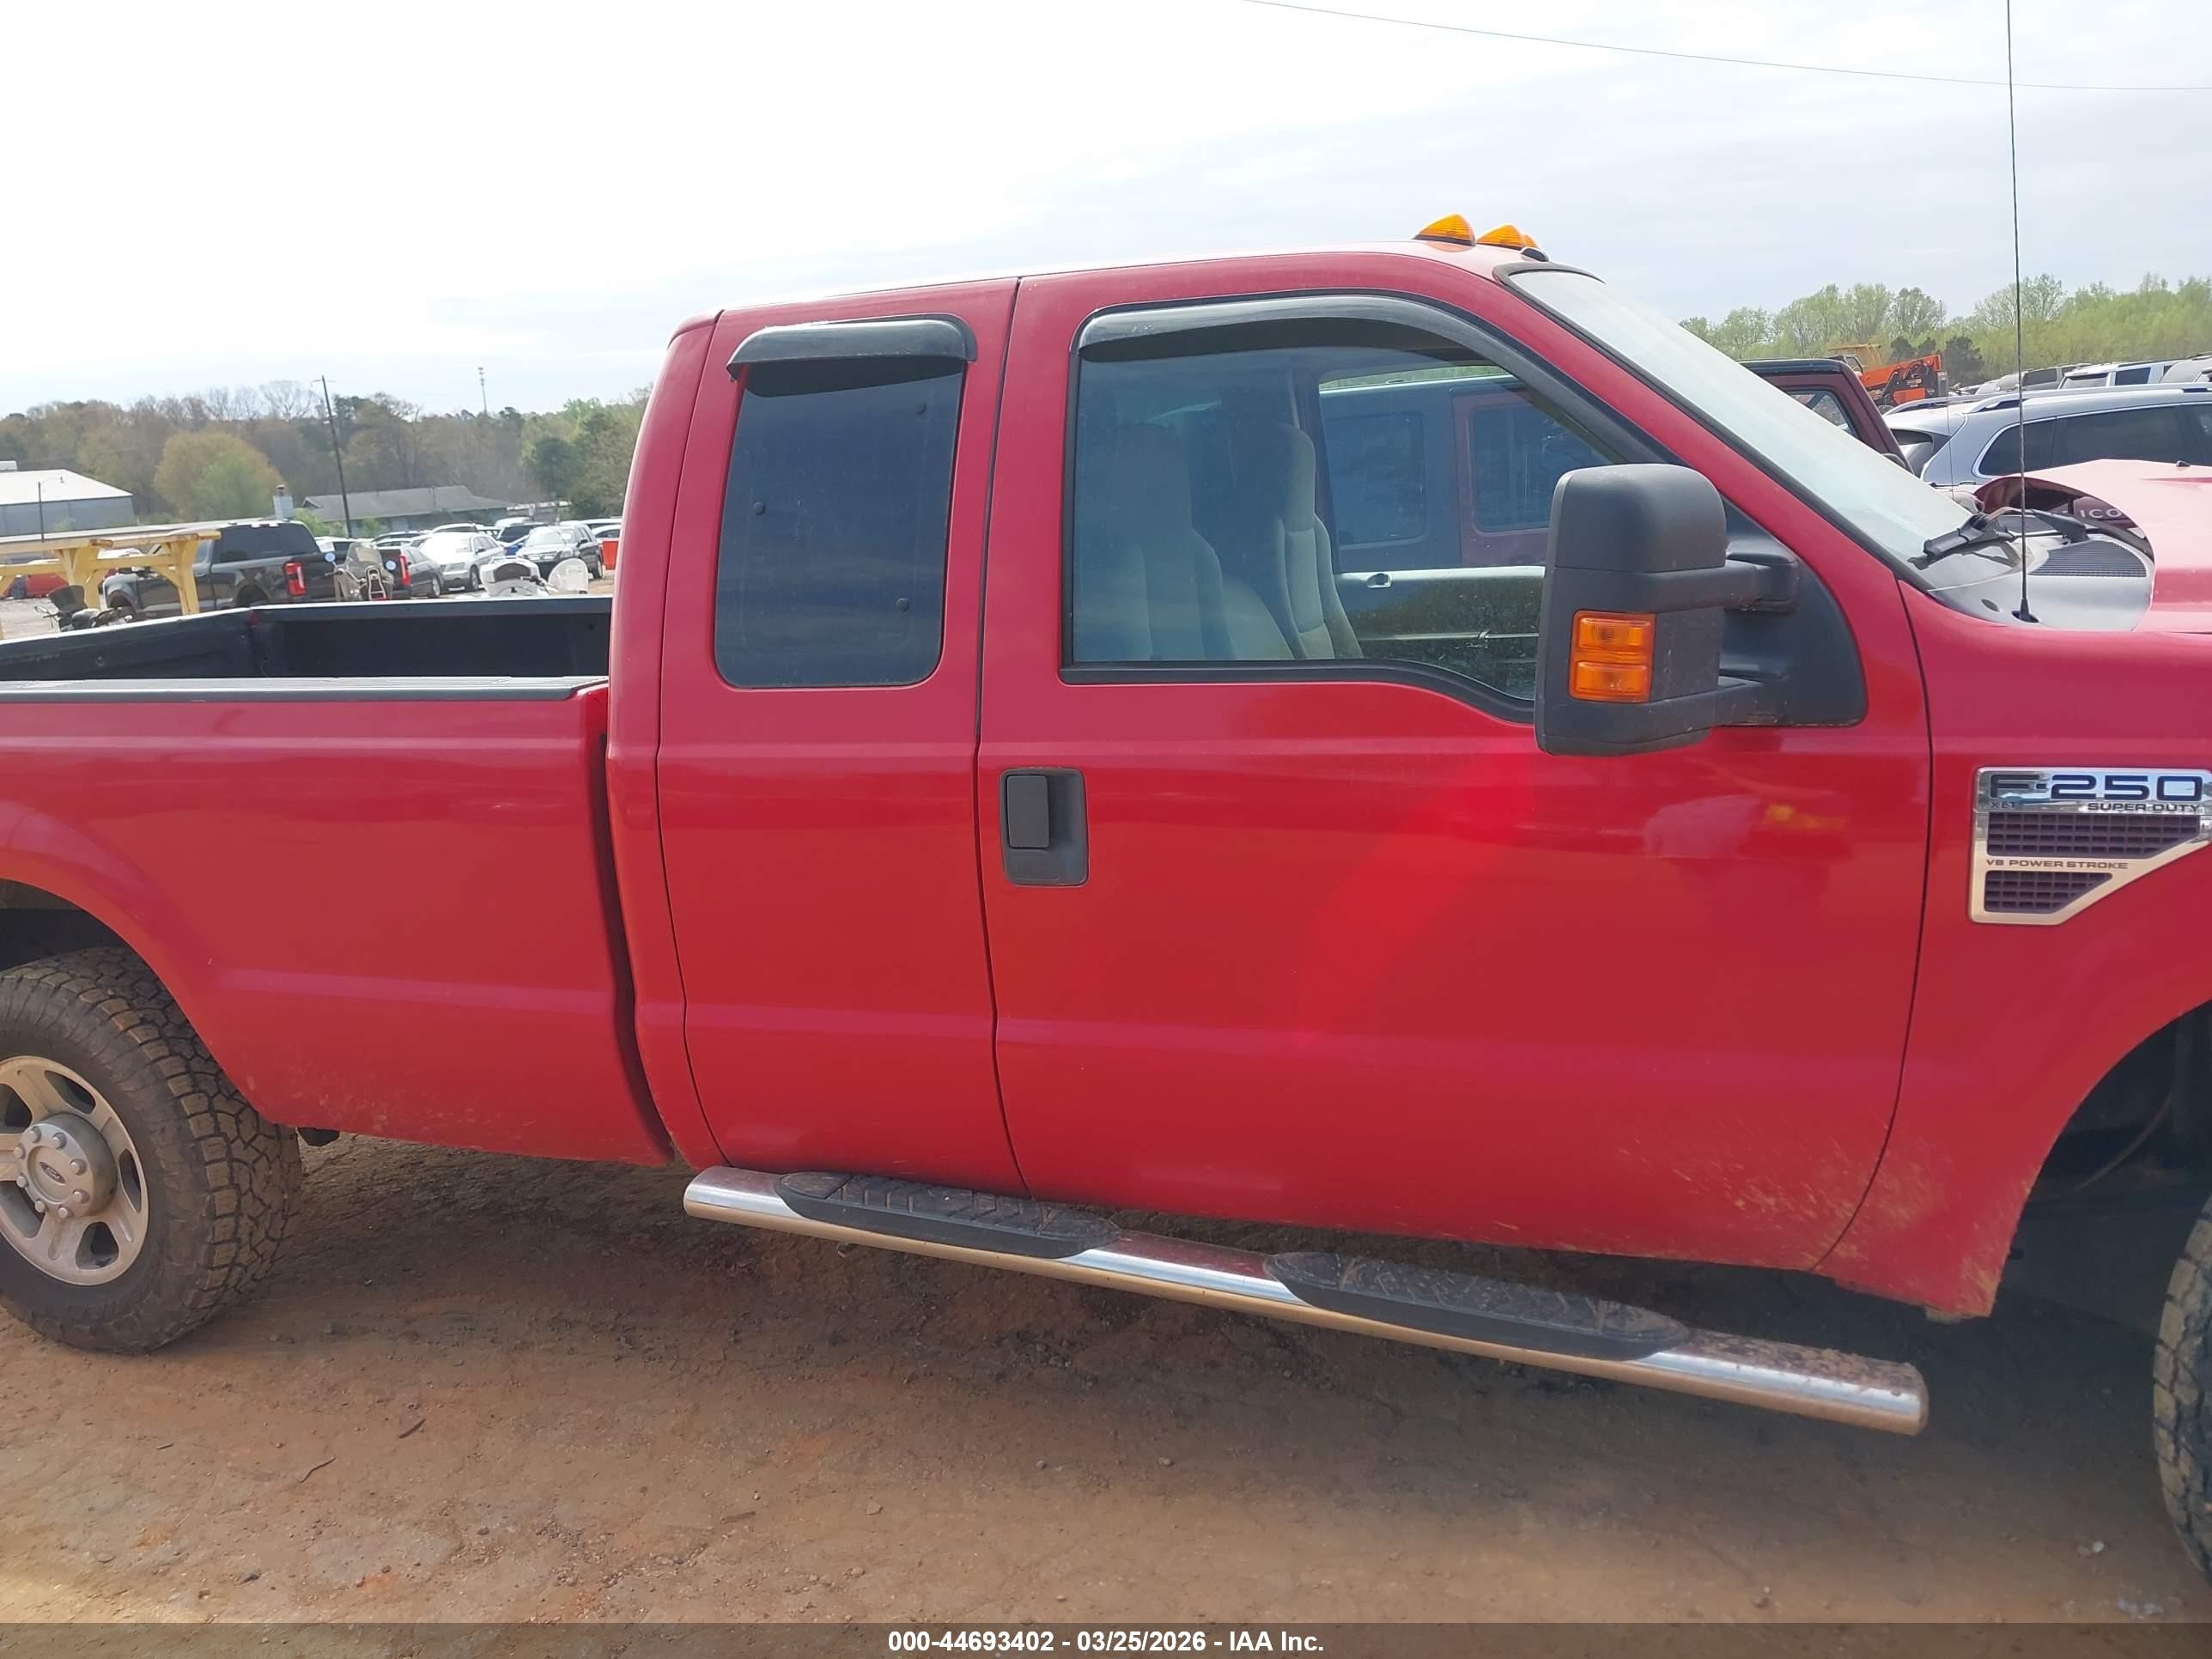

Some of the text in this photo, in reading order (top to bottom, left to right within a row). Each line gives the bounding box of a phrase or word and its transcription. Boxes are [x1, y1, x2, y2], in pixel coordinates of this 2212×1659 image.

[1990, 774, 2203, 801] F-250
[2087, 802, 2201, 813] SUPER DUTY
[2009, 860, 2063, 868] POWER
[2066, 861, 2129, 870] STROKE
